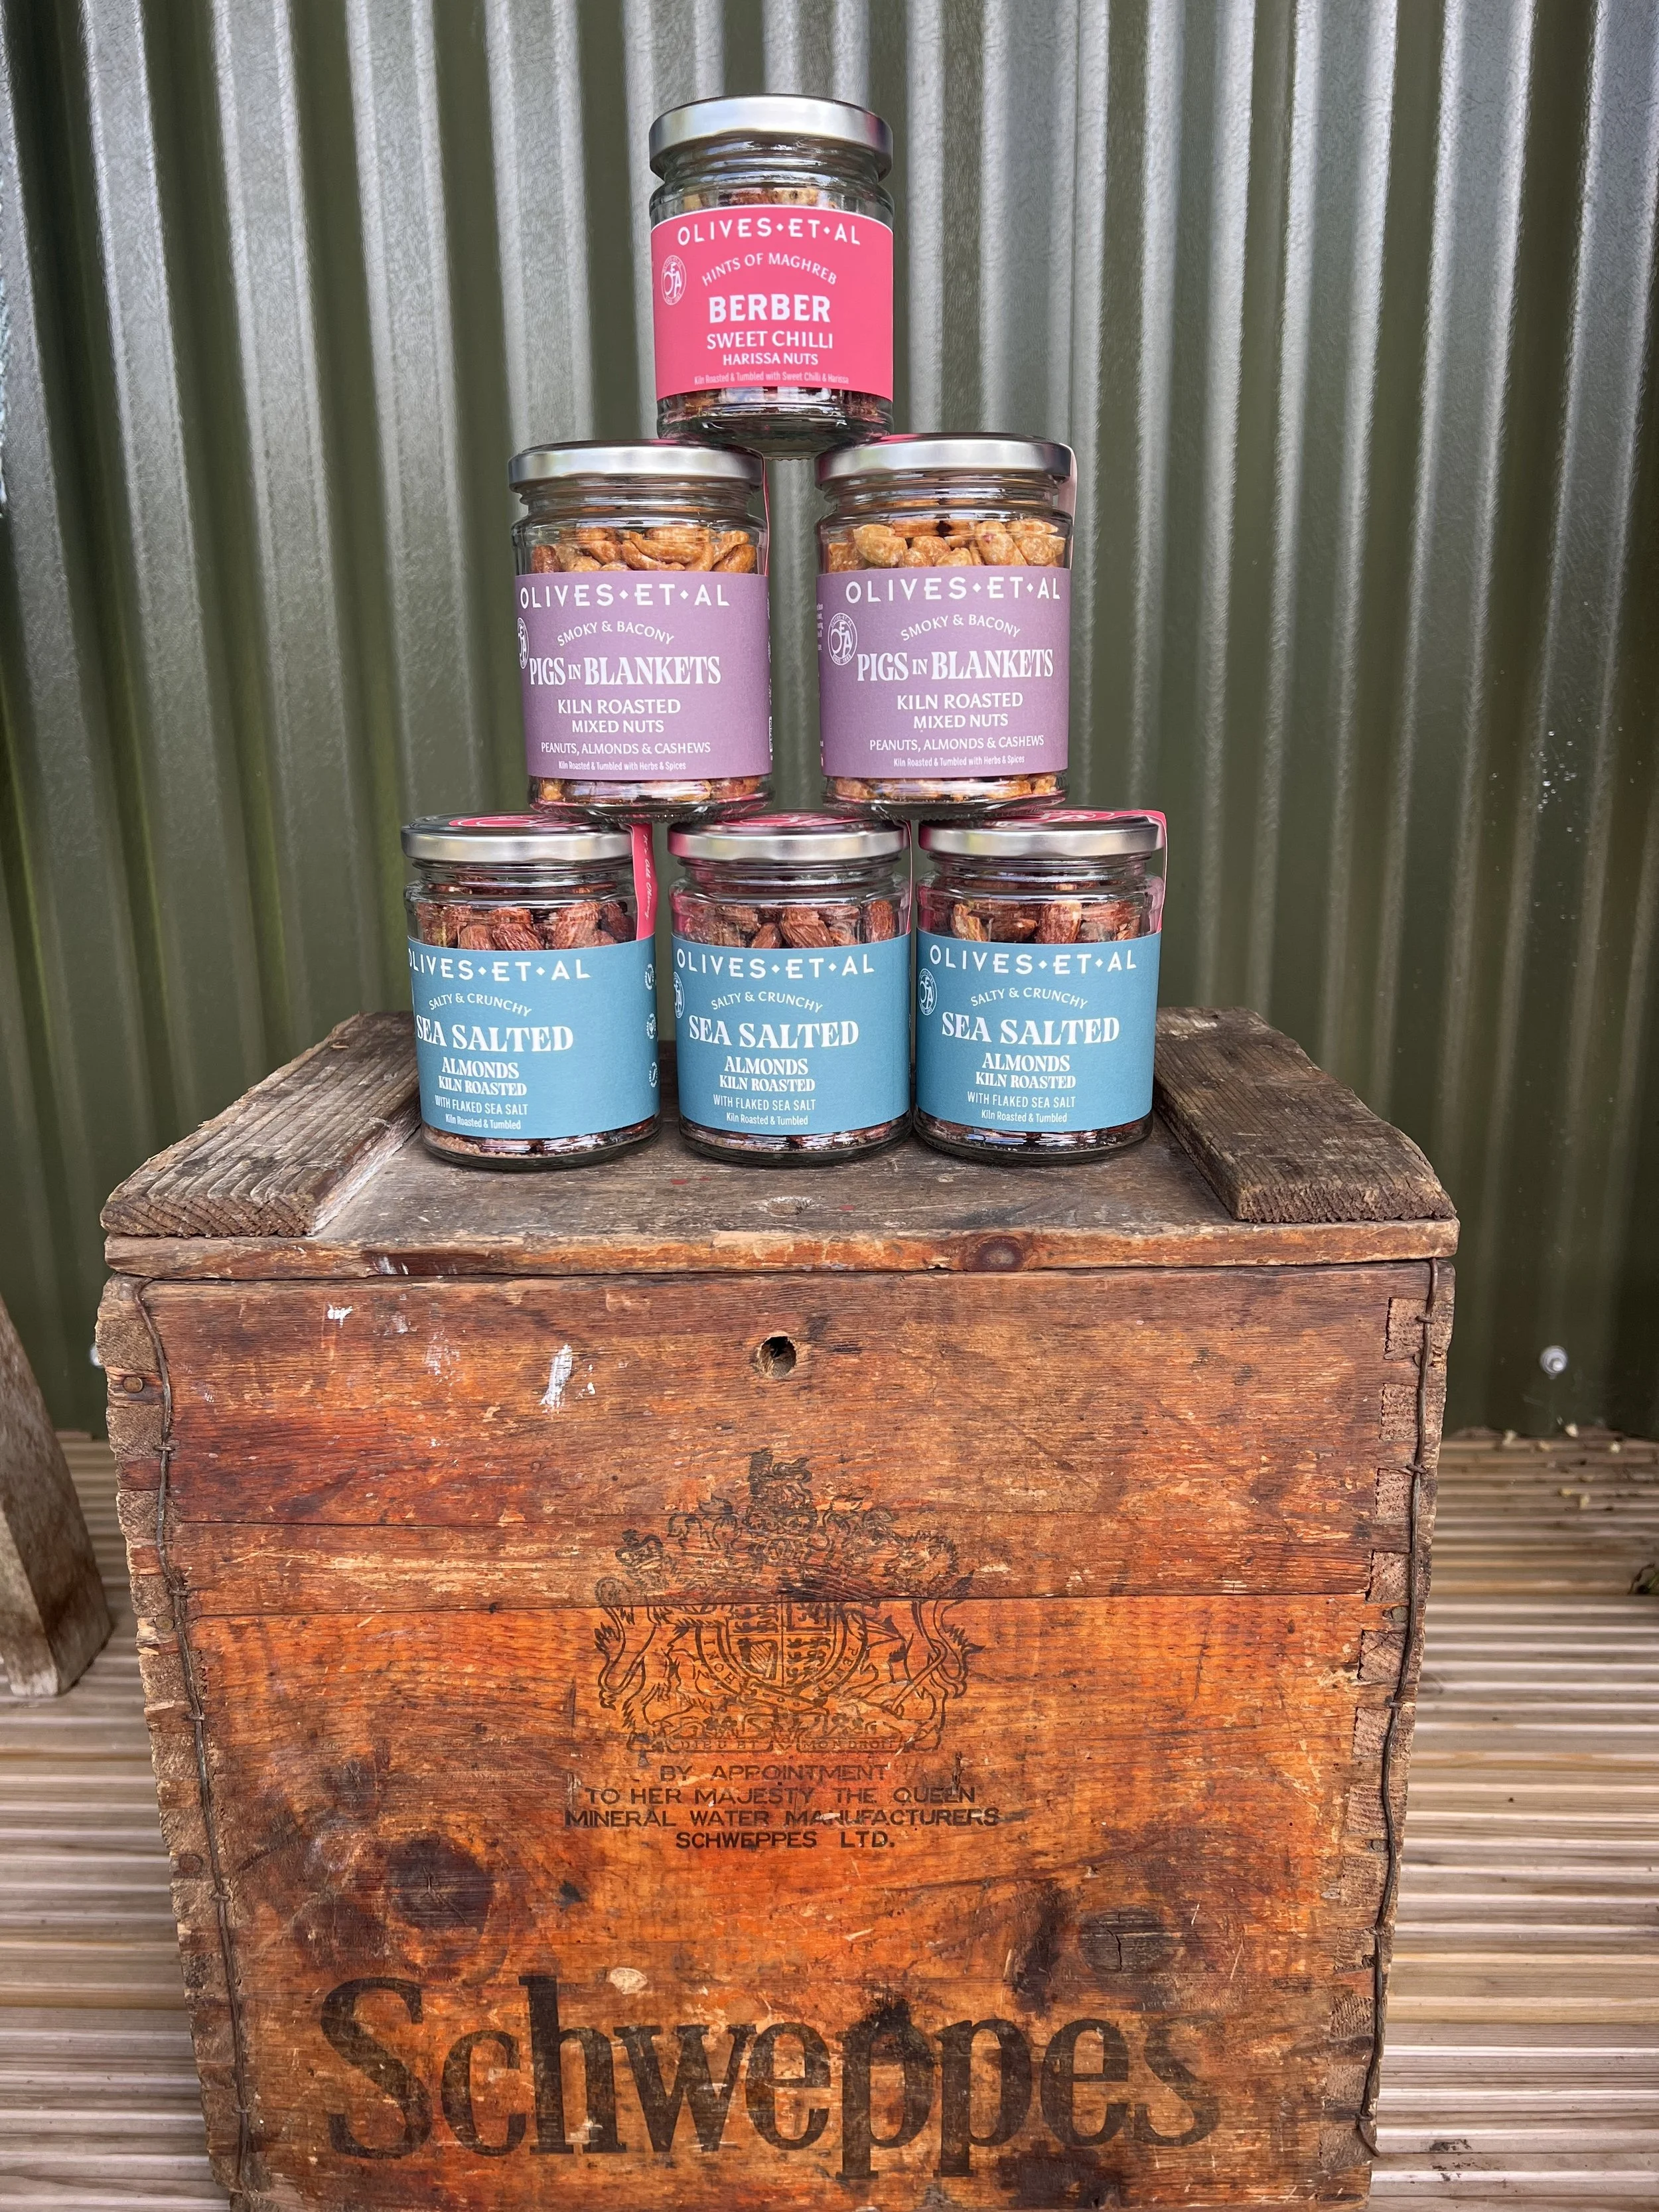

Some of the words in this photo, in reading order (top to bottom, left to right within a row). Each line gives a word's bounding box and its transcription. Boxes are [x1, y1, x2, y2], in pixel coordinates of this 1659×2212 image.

[701, 257, 741, 287] HINTS
[745, 253, 764, 267] OF
[768, 252, 837, 285] MAGHREB
[709, 294, 831, 323] BERBER
[707, 331, 768, 350] SWEET
[772, 331, 833, 349] CHILLI
[723, 352, 781, 366] HARISSA
[783, 352, 818, 366] NUTS
[694, 376, 705, 385] Kiln
[705, 374, 730, 384] Roasted
[731, 373, 735, 382] &
[736, 372, 764, 382] Tumbled
[765, 372, 781, 381] with
[782, 372, 803, 381] Sweet
[804, 373, 821, 382] Chilli
[828, 375, 849, 384] Harissa
[557, 622, 598, 646] SMOKY
[602, 621, 613, 632] &
[617, 621, 674, 645] BACONY
[901, 615, 949, 641] SMOKY
[952, 614, 964, 626] &
[969, 615, 1021, 638] BACONY
[529, 657, 566, 685] PIGS
[568, 664, 581, 680] IN
[584, 656, 721, 685] BLANKETS
[857, 652, 909, 681] PIGS
[912, 658, 928, 675] IN
[931, 649, 1054, 680] BLANKETS
[557, 699, 592, 714] KILN
[597, 699, 681, 714] ROASTED
[897, 694, 939, 710] KILN
[944, 692, 1023, 709] ROASTED
[572, 720, 618, 733] MIXED
[623, 719, 664, 733] NUTS
[914, 715, 966, 729] MIXED
[970, 713, 1009, 729] NUTS
[541, 742, 580, 756] PEANUTS,
[581, 743, 639, 754] ALMONDS
[642, 743, 652, 754] &
[654, 742, 711, 754] CASHEWS
[869, 739, 921, 753] PEANUTS,
[924, 738, 984, 751] ALMONDS
[987, 738, 997, 749] &
[998, 735, 1044, 748] CASHEWS
[569, 761, 589, 770] Roasted
[597, 761, 622, 771] Tumbled
[666, 761, 686, 772] Spices
[893, 758, 906, 767] Kiln
[907, 758, 932, 767] Roasted
[934, 758, 939, 767] &
[940, 757, 967, 767] Tumbled
[968, 757, 982, 765] with
[983, 756, 1001, 765] Herbs
[1007, 755, 1025, 765] Spices
[429, 993, 453, 1011] SALTY
[455, 993, 465, 1003] &
[467, 994, 532, 1017] CRUNCHY
[711, 992, 741, 1010] SALTY
[745, 992, 755, 1002] &
[758, 992, 823, 1013] CRUNCHY
[971, 988, 1005, 1007] SALTY
[1009, 987, 1019, 998] &
[1023, 987, 1088, 1009] CRUNCHY
[416, 1014, 447, 1047] SEA
[453, 1024, 573, 1052] SALTED
[689, 1015, 732, 1045] SEA
[739, 1021, 859, 1049] SALTED
[942, 1011, 991, 1043] SEA
[1000, 1017, 1119, 1045] SALTED
[441, 1057, 520, 1078] ALMONDS
[724, 1056, 808, 1075] ALMONDS
[981, 1052, 1070, 1072] ALMONDS
[438, 1076, 462, 1092] KILN
[465, 1082, 527, 1096] ROASTED
[719, 1074, 748, 1090] KILN
[751, 1078, 816, 1092] ROASTED
[975, 1071, 1007, 1088] KILN
[1010, 1074, 1076, 1089] ROASTED
[435, 1095, 451, 1108] WITH
[453, 1099, 482, 1114] FLAKED
[484, 1102, 503, 1115] SEA
[506, 1104, 528, 1115] SALT
[713, 1094, 733, 1107] WITH
[736, 1097, 769, 1110] FLAKED
[772, 1098, 790, 1111] SEA
[794, 1099, 816, 1110] SALT
[968, 1091, 989, 1105] WITH
[992, 1094, 1029, 1108] FLAKED
[1031, 1096, 1050, 1108] SEA
[1053, 1096, 1076, 1108] SALT
[445, 1114, 456, 1124] Kiln
[457, 1117, 482, 1128] Roasted
[483, 1119, 488, 1128] &
[490, 1120, 521, 1130] Tumbled
[726, 1112, 739, 1122] Kiln
[740, 1114, 768, 1125] Roasted
[770, 1116, 775, 1125] &
[776, 1115, 808, 1126] Tumbled
[981, 1110, 995, 1120] Kiln
[997, 1111, 1027, 1122] Roasted
[1029, 1113, 1034, 1122] &
[1035, 1112, 1067, 1123] Tumbled
[680, 1739, 727, 1750] DIEU
[803, 1739, 845, 1750] MON
[660, 1765, 693, 1781] BY
[710, 1765, 887, 1781] APPOINTMENT
[585, 1788, 621, 1805] TO
[630, 1788, 682, 1805] HER
[694, 1788, 815, 1805] MAJESTY
[834, 1787, 875, 1805] THE
[893, 1787, 975, 1805] QUEEN
[565, 1810, 680, 1828] MINERAL
[689, 1810, 770, 1826] WATER
[786, 1808, 999, 1827] MANUFACTURERS
[676, 1832, 817, 1849] SCHWEPPES
[841, 1831, 895, 1848] LTD.
[320, 1976, 1216, 2179] Schweppes
